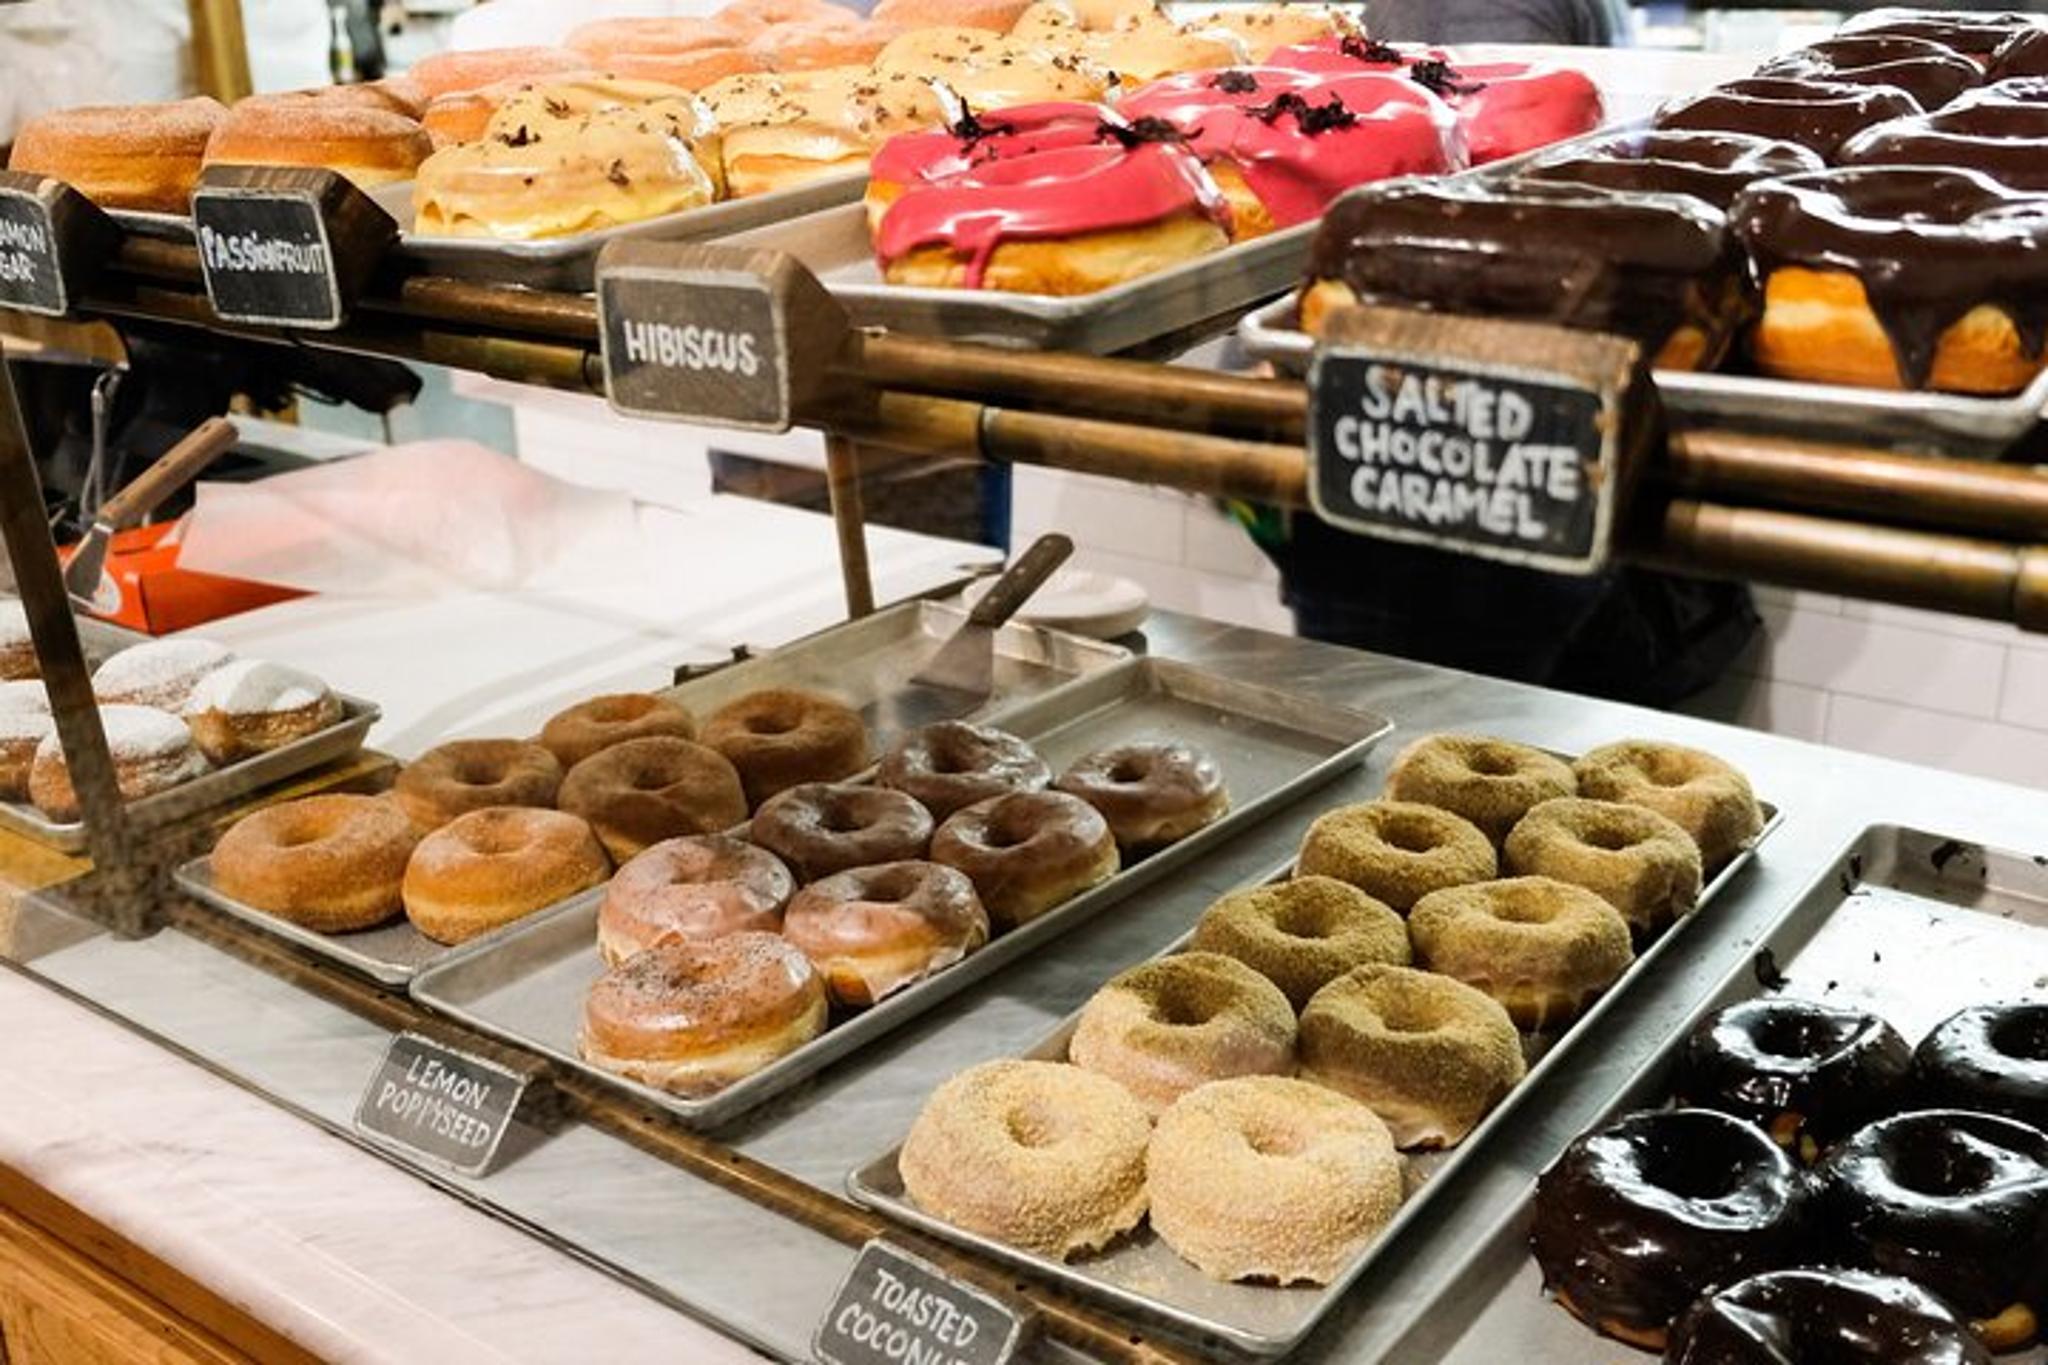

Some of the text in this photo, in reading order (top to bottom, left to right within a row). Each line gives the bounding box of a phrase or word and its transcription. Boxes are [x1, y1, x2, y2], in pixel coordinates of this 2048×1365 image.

[623, 318, 758, 377] HIBISCUS
[1361, 365, 1534, 441] SALTED
[1334, 415, 1580, 501] CHOCOLATE
[1350, 465, 1547, 540] CARAMEL
[377, 1081, 491, 1148] POPPYSEED
[406, 1055, 491, 1110] LEMON
[836, 1302, 970, 1365] COCON
[872, 1267, 979, 1347] TOASTED
